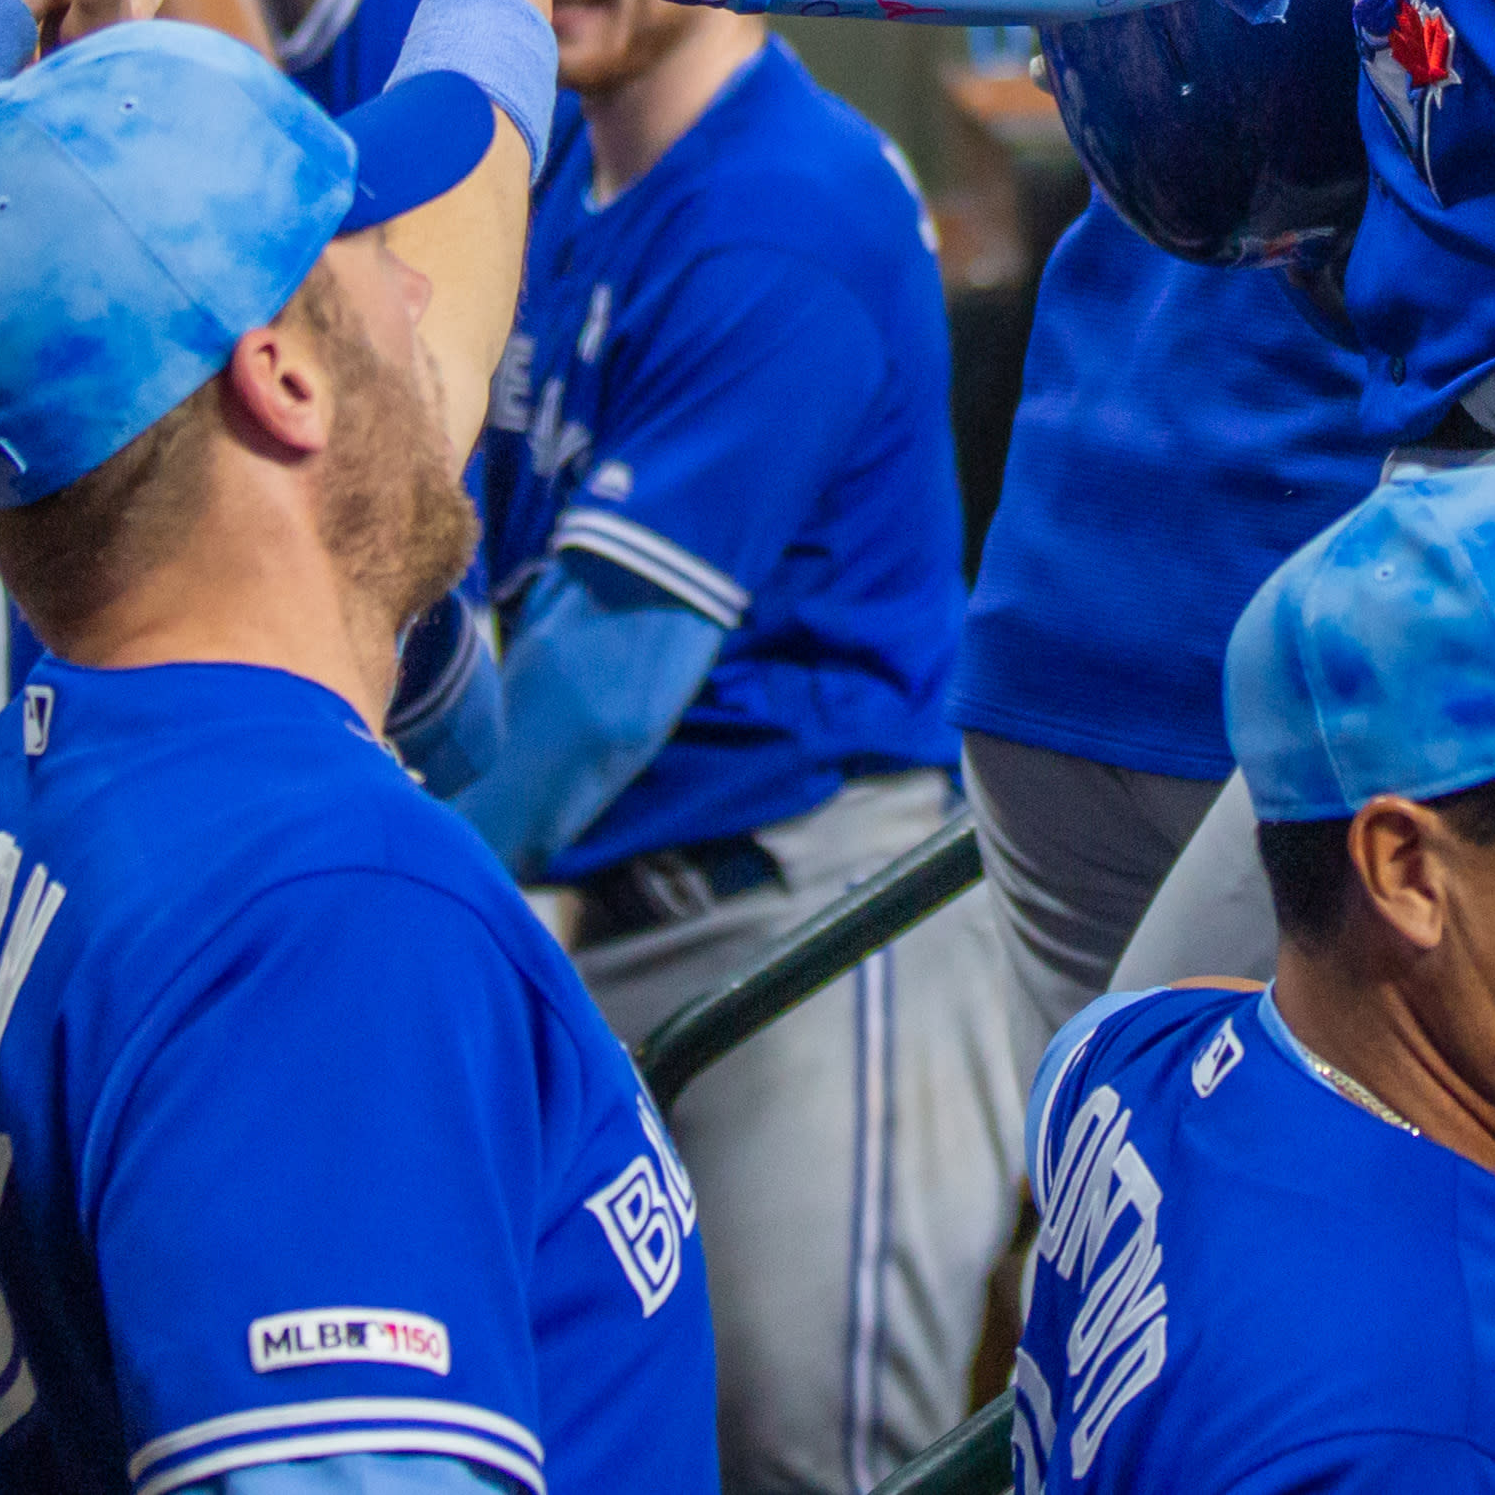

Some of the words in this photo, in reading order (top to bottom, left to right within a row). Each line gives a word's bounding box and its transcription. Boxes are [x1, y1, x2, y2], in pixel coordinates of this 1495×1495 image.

[583, 1092, 698, 1319] BL
[1038, 1084, 1168, 1481] ONTOYO
[262, 1322, 343, 1359] MLB
